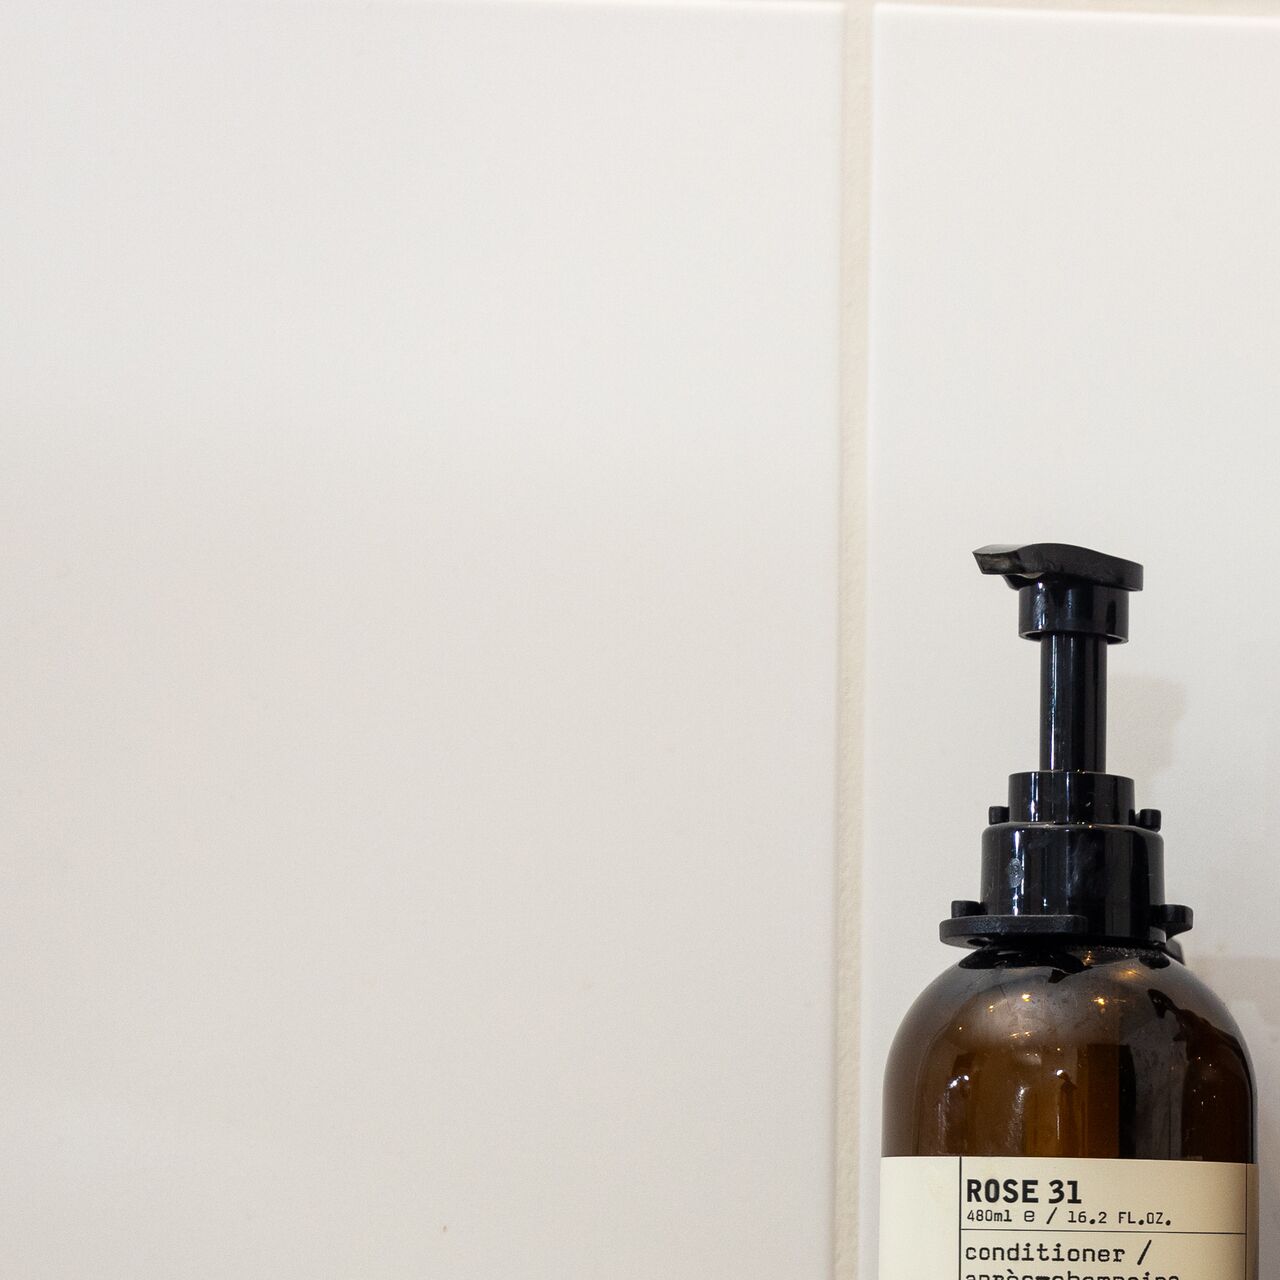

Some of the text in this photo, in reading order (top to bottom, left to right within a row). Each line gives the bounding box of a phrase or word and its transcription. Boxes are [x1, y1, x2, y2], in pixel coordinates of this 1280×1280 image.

[967, 1178, 1082, 1204] ROSE 31
[967, 1209, 1012, 1222] 480ml
[1046, 1207, 1058, 1224] /
[1067, 1211, 1107, 1225] 16.2
[1118, 1211, 1171, 1226] FL.OZ.
[965, 1240, 1152, 1266] conditioner /
